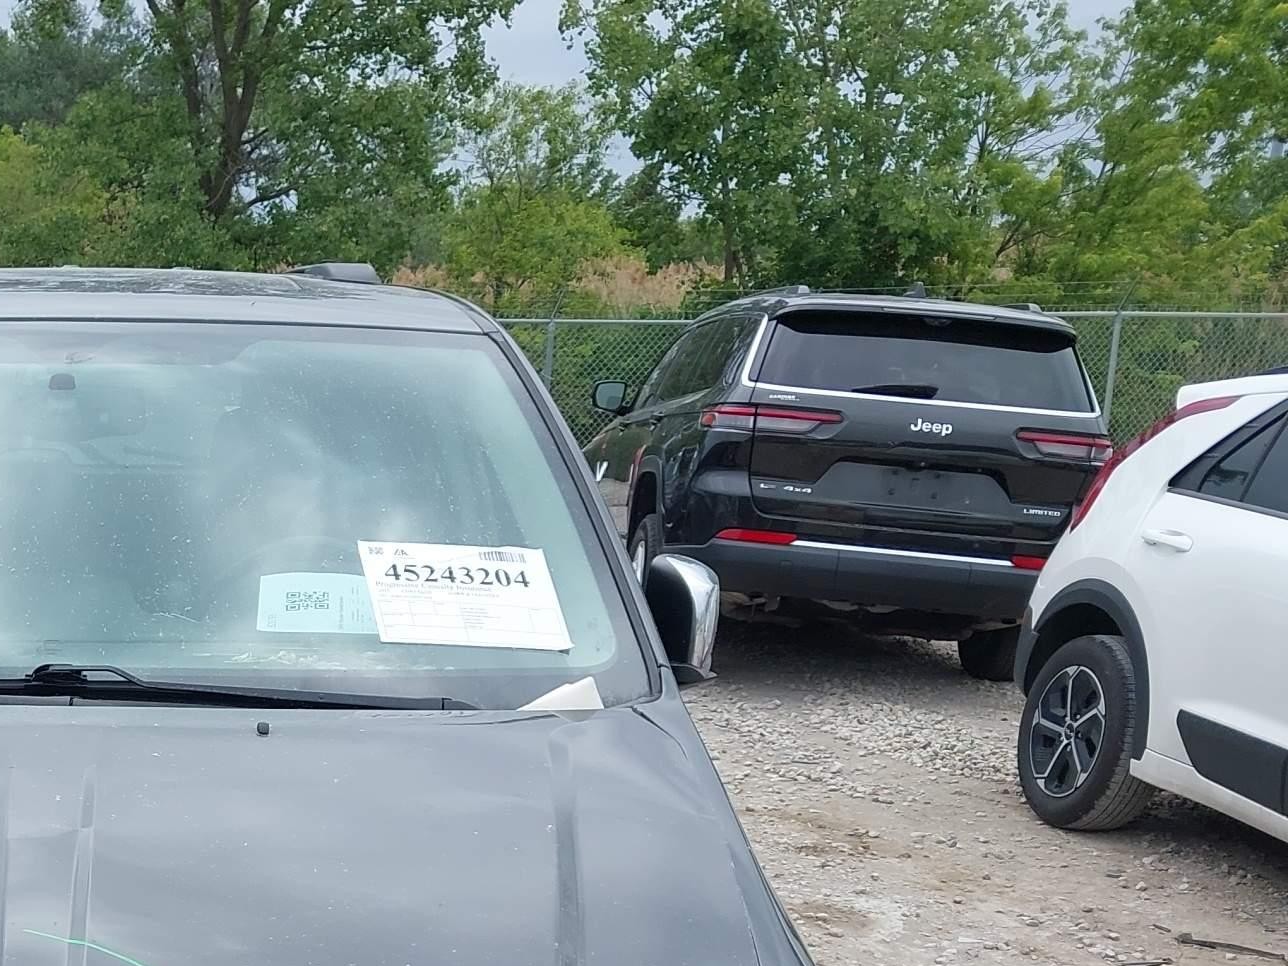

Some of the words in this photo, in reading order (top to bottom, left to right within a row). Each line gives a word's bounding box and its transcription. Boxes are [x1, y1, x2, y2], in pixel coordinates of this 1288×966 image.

[911, 418, 953, 436] Jeep
[1024, 508, 1061, 517] LIMITED
[384, 563, 530, 588] 45243204
